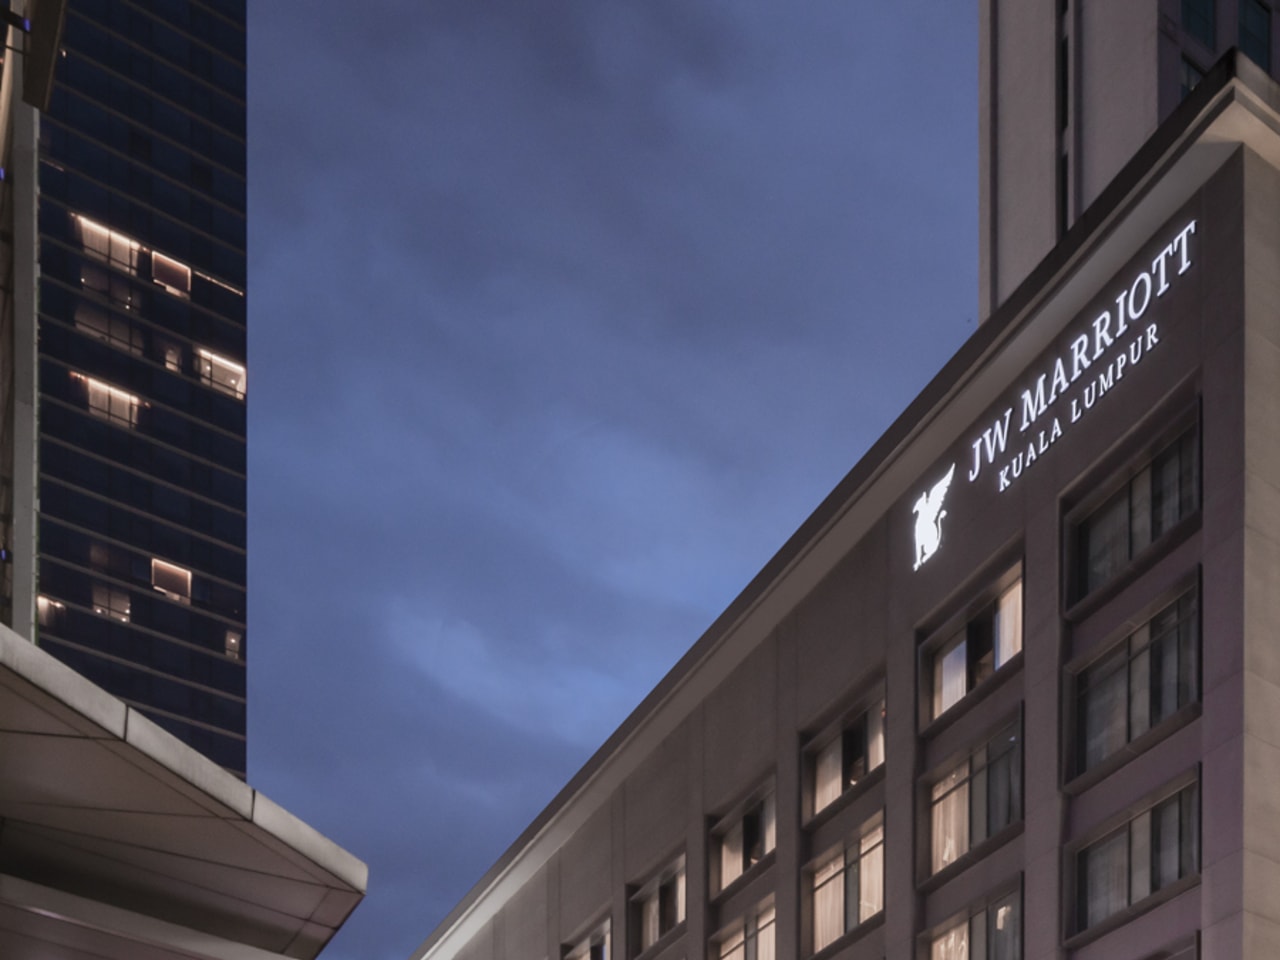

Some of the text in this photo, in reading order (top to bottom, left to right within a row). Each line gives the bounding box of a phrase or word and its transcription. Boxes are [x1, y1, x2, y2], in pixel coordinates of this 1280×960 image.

[969, 219, 1198, 482] JW MARRIOTT
[998, 322, 1161, 493] KUALA LUMPUR
